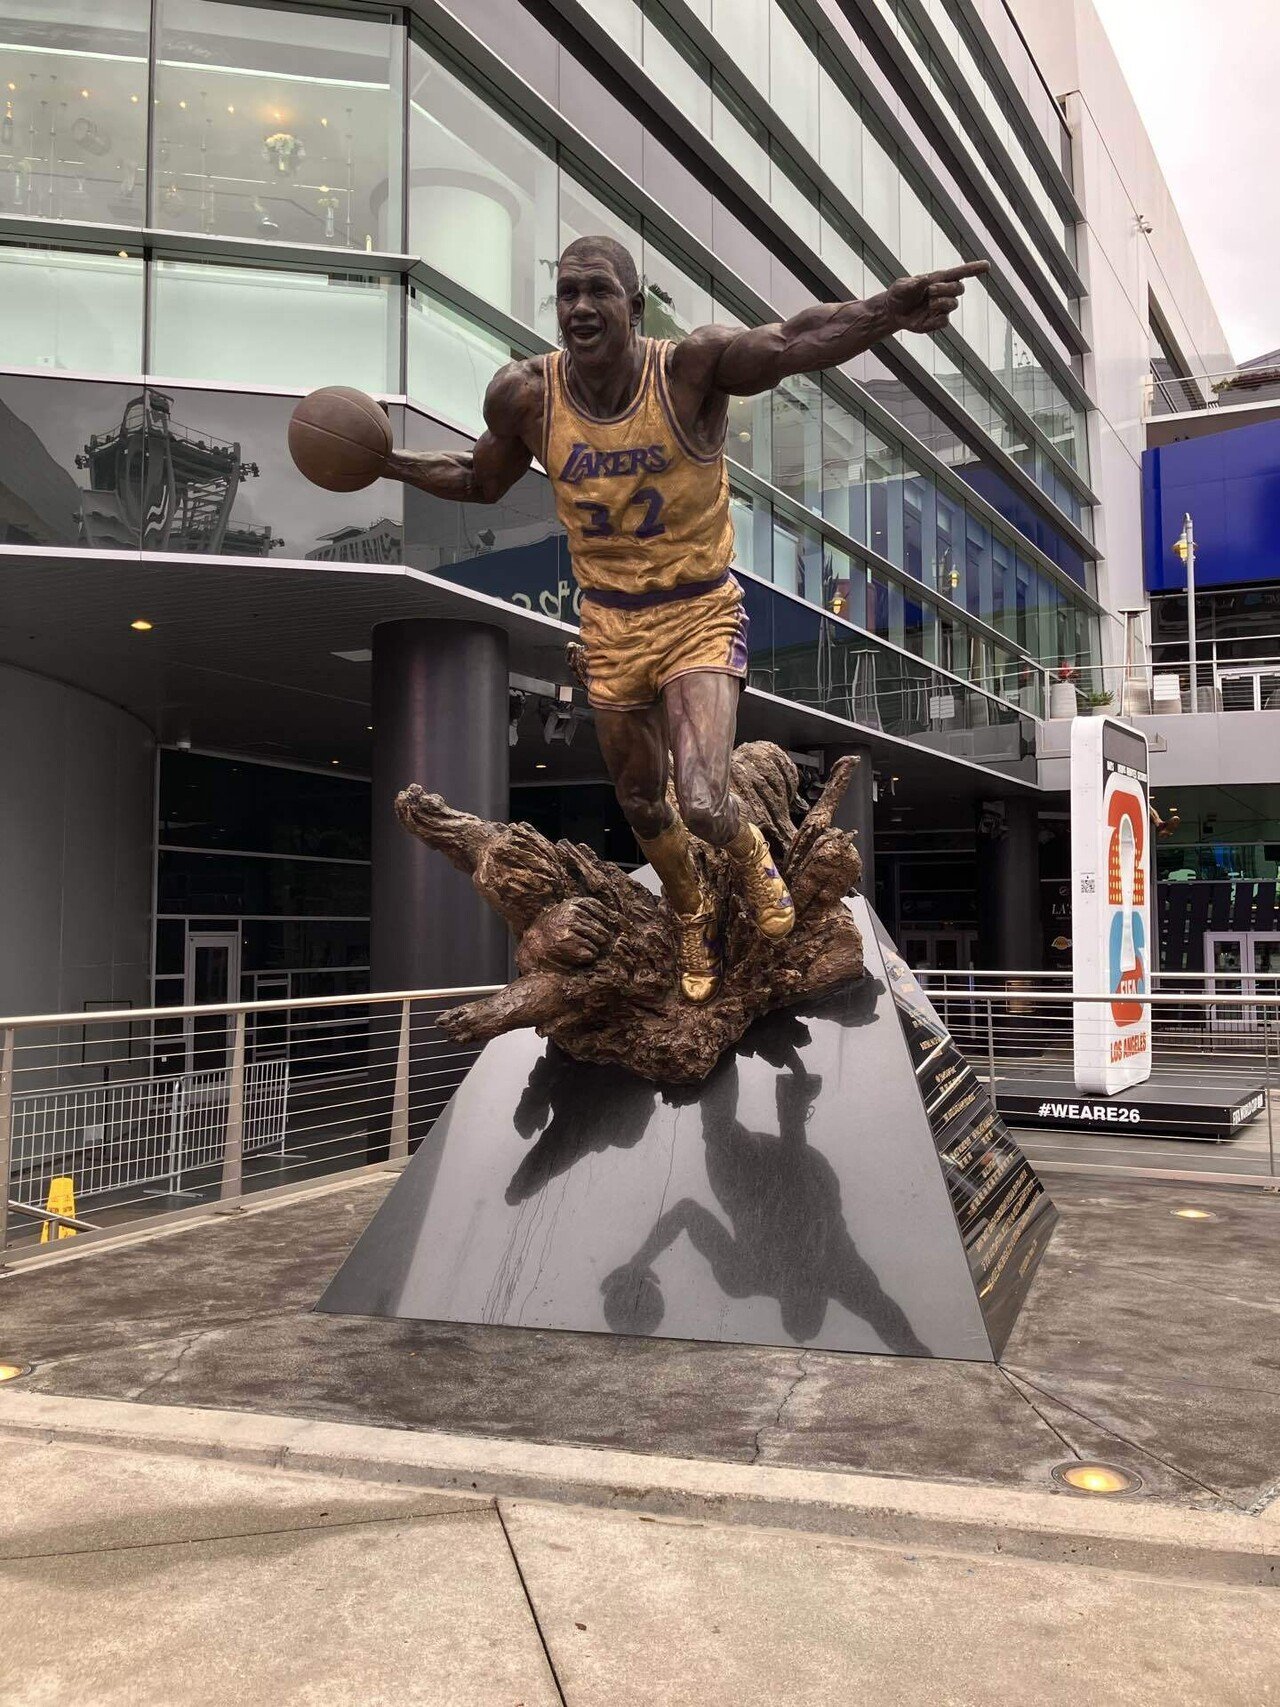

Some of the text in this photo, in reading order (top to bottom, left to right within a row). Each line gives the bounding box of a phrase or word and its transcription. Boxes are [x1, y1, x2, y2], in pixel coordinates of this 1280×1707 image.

[560, 442, 673, 485] LAKERS
[574, 486, 666, 539] 32
[1052, 903, 1072, 915] LA'
[1110, 1032, 1147, 1064] LOS ANGELES
[1038, 1102, 1141, 1123] #WEARE26
